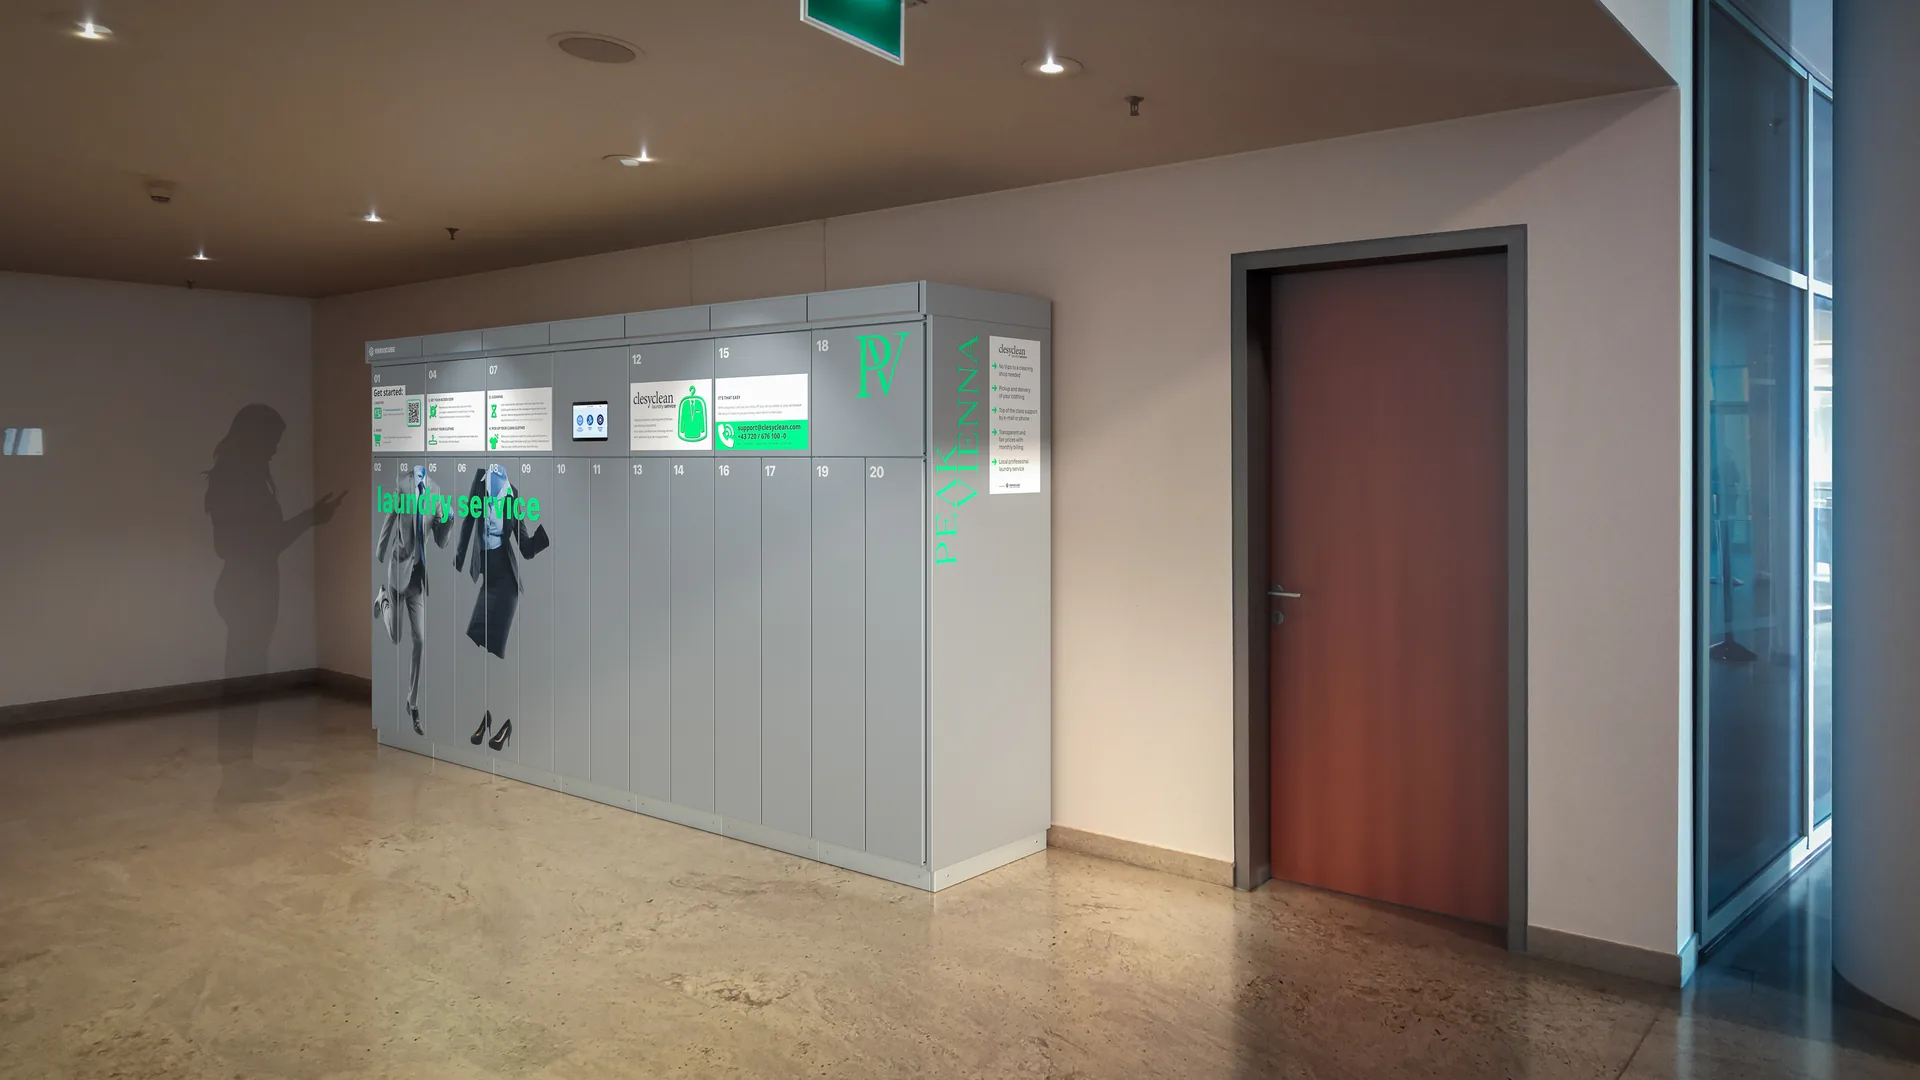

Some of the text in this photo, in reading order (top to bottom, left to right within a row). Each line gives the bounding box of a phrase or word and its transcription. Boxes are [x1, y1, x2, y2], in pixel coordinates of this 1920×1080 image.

[816, 339, 829, 352] 18
[998, 344, 1026, 356] clesyclean
[718, 347, 730, 359] 15
[631, 354, 642, 365] 12
[428, 370, 437, 380] 04
[489, 365, 498, 375] 07
[373, 374, 381, 383] 01
[373, 387, 404, 397] Get started:
[633, 391, 674, 409] clesyclean
[737, 424, 801, 432] support@clesyclean.com
[374, 463, 382, 471] 02
[400, 463, 408, 472] 03
[428, 463, 437, 472] 05
[457, 463, 467, 473] 06
[521, 463, 531, 473] 09
[557, 464, 566, 474] 10
[593, 464, 601, 475] 11
[632, 465, 643, 475] 13
[673, 465, 684, 476] 14
[718, 465, 730, 476] 16
[765, 465, 776, 477] 17
[816, 465, 829, 478] 19
[869, 466, 884, 478] 20
[377, 485, 541, 524] laundry service
